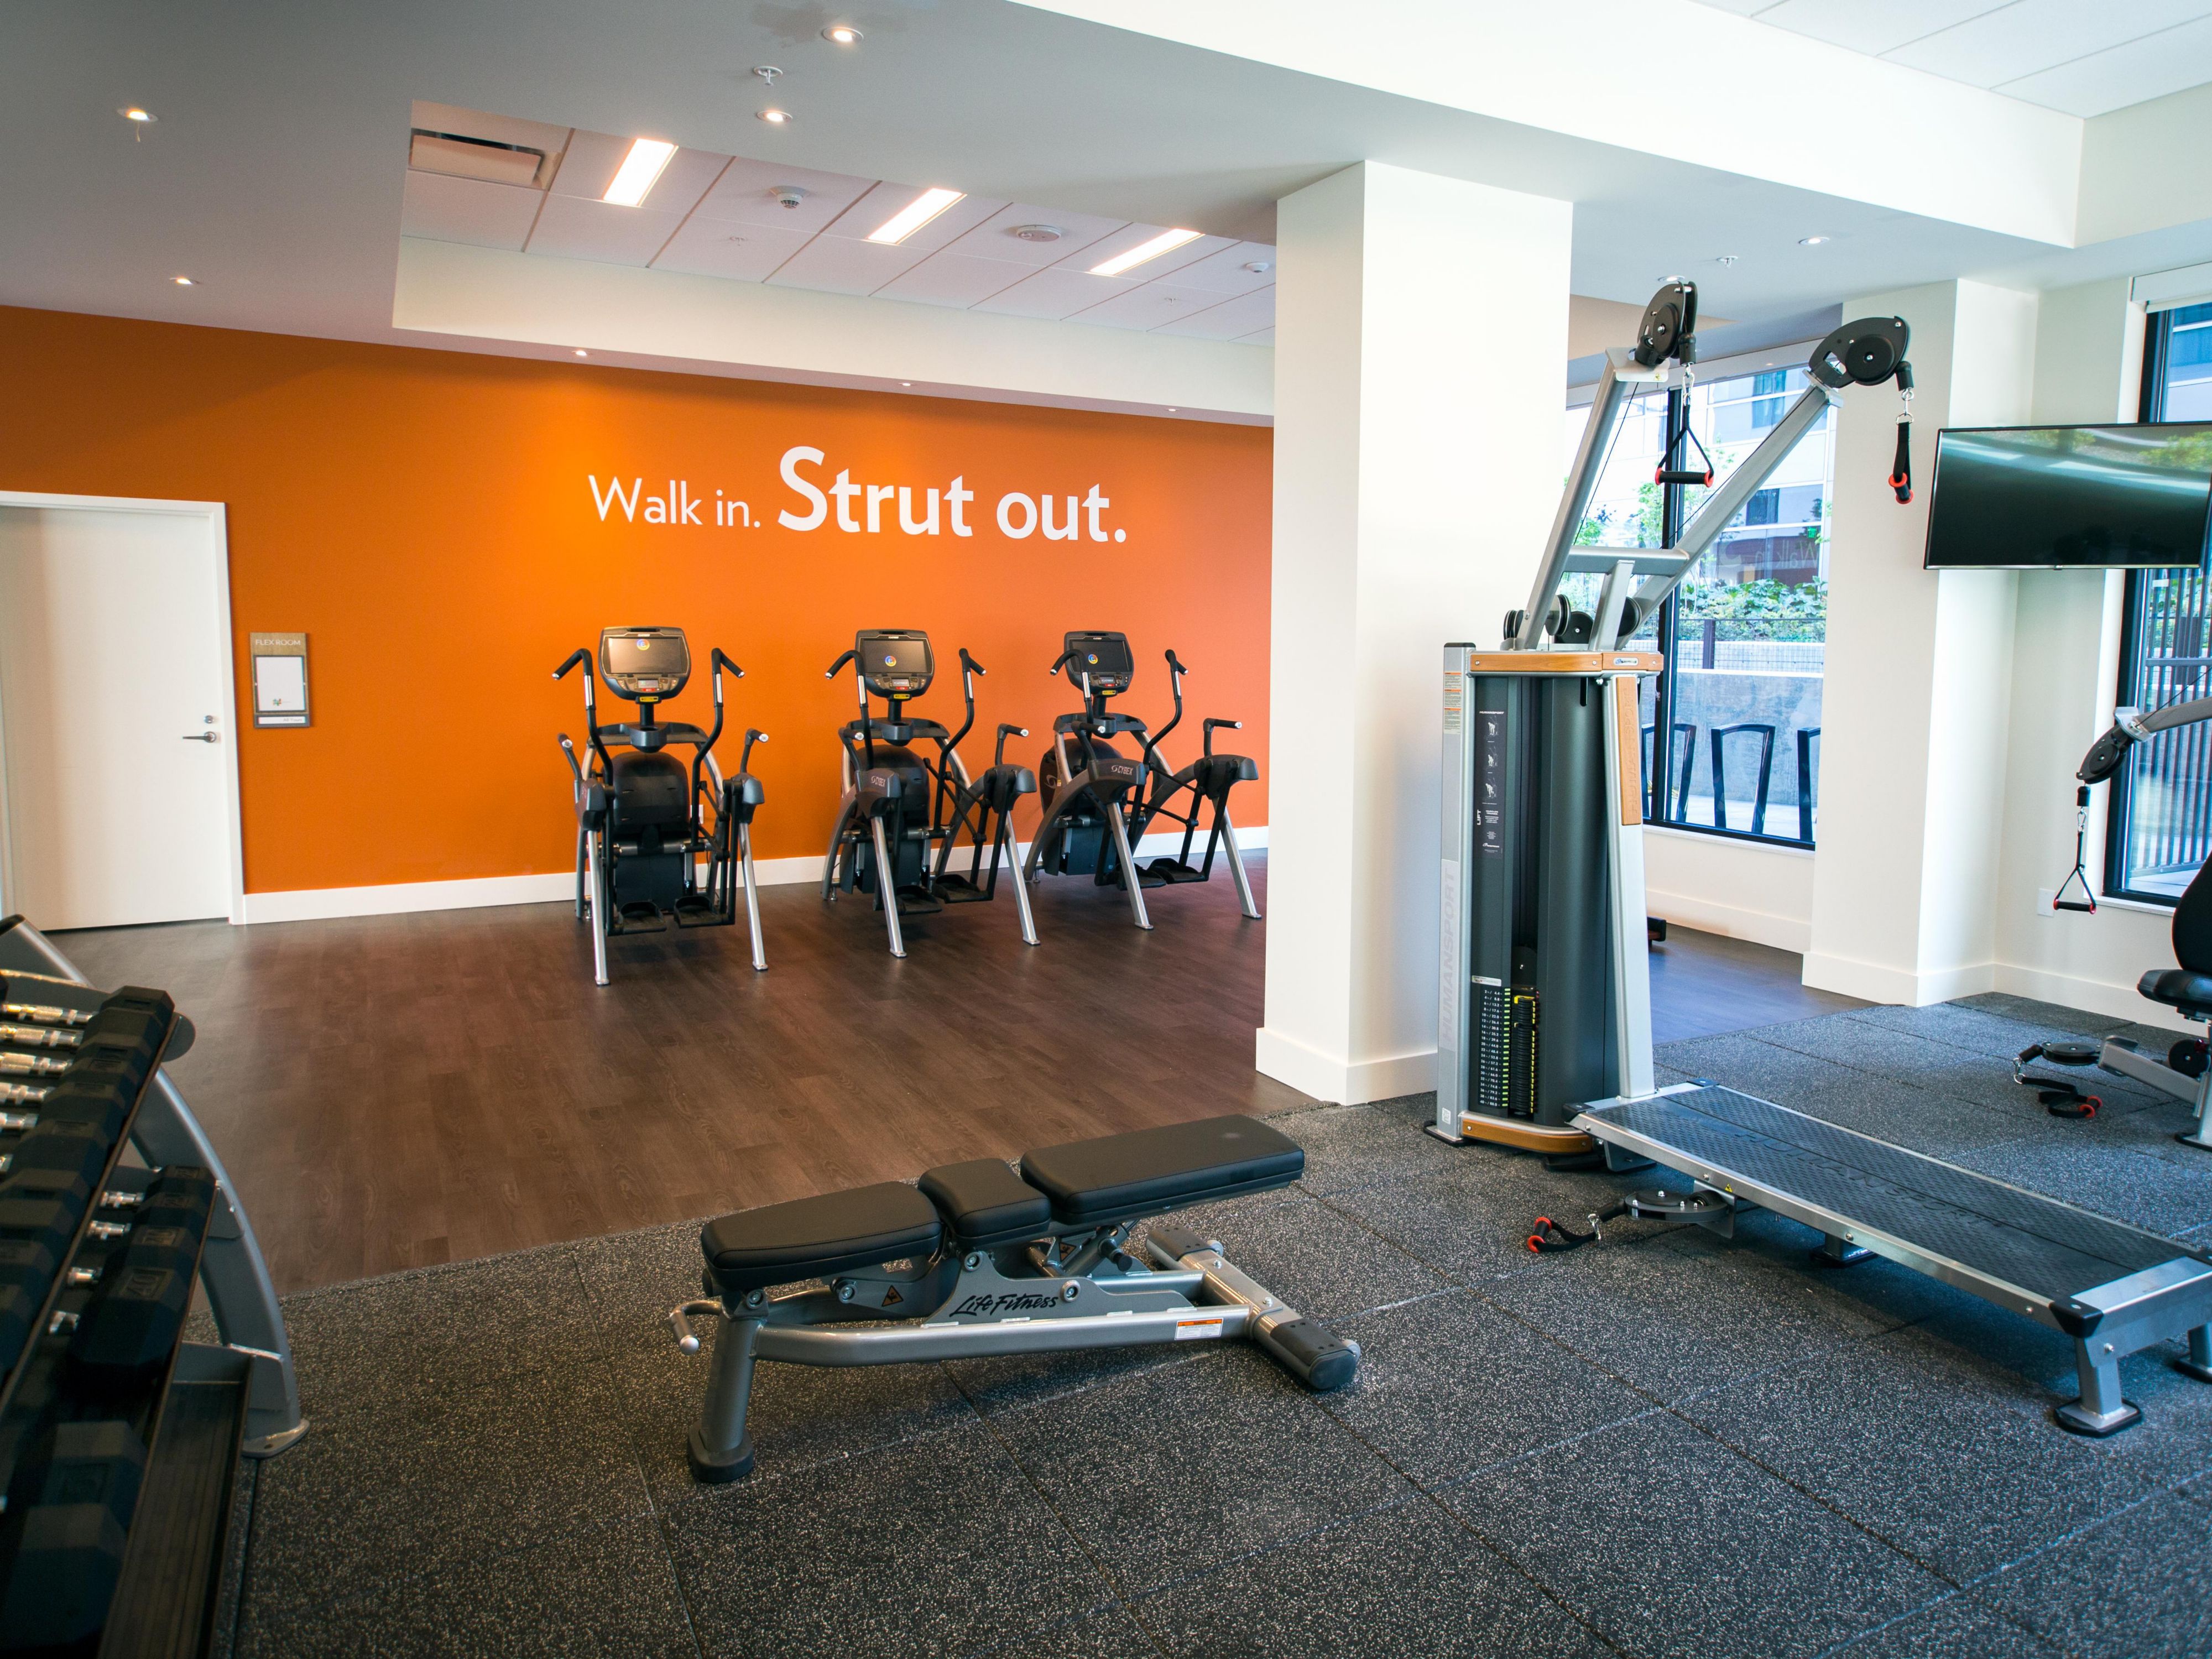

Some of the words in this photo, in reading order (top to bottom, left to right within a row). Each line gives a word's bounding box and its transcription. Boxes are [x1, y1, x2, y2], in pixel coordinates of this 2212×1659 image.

[588, 474, 702, 525] Walk
[716, 489, 760, 528] in.
[777, 445, 974, 537] Strut
[995, 483, 1126, 543] out.
[1118, 765, 1134, 775] CYBEX
[1441, 867, 1455, 1042] HUMANSPORT
[949, 1295, 994, 1318] Life
[990, 1293, 1058, 1316] Fitness
